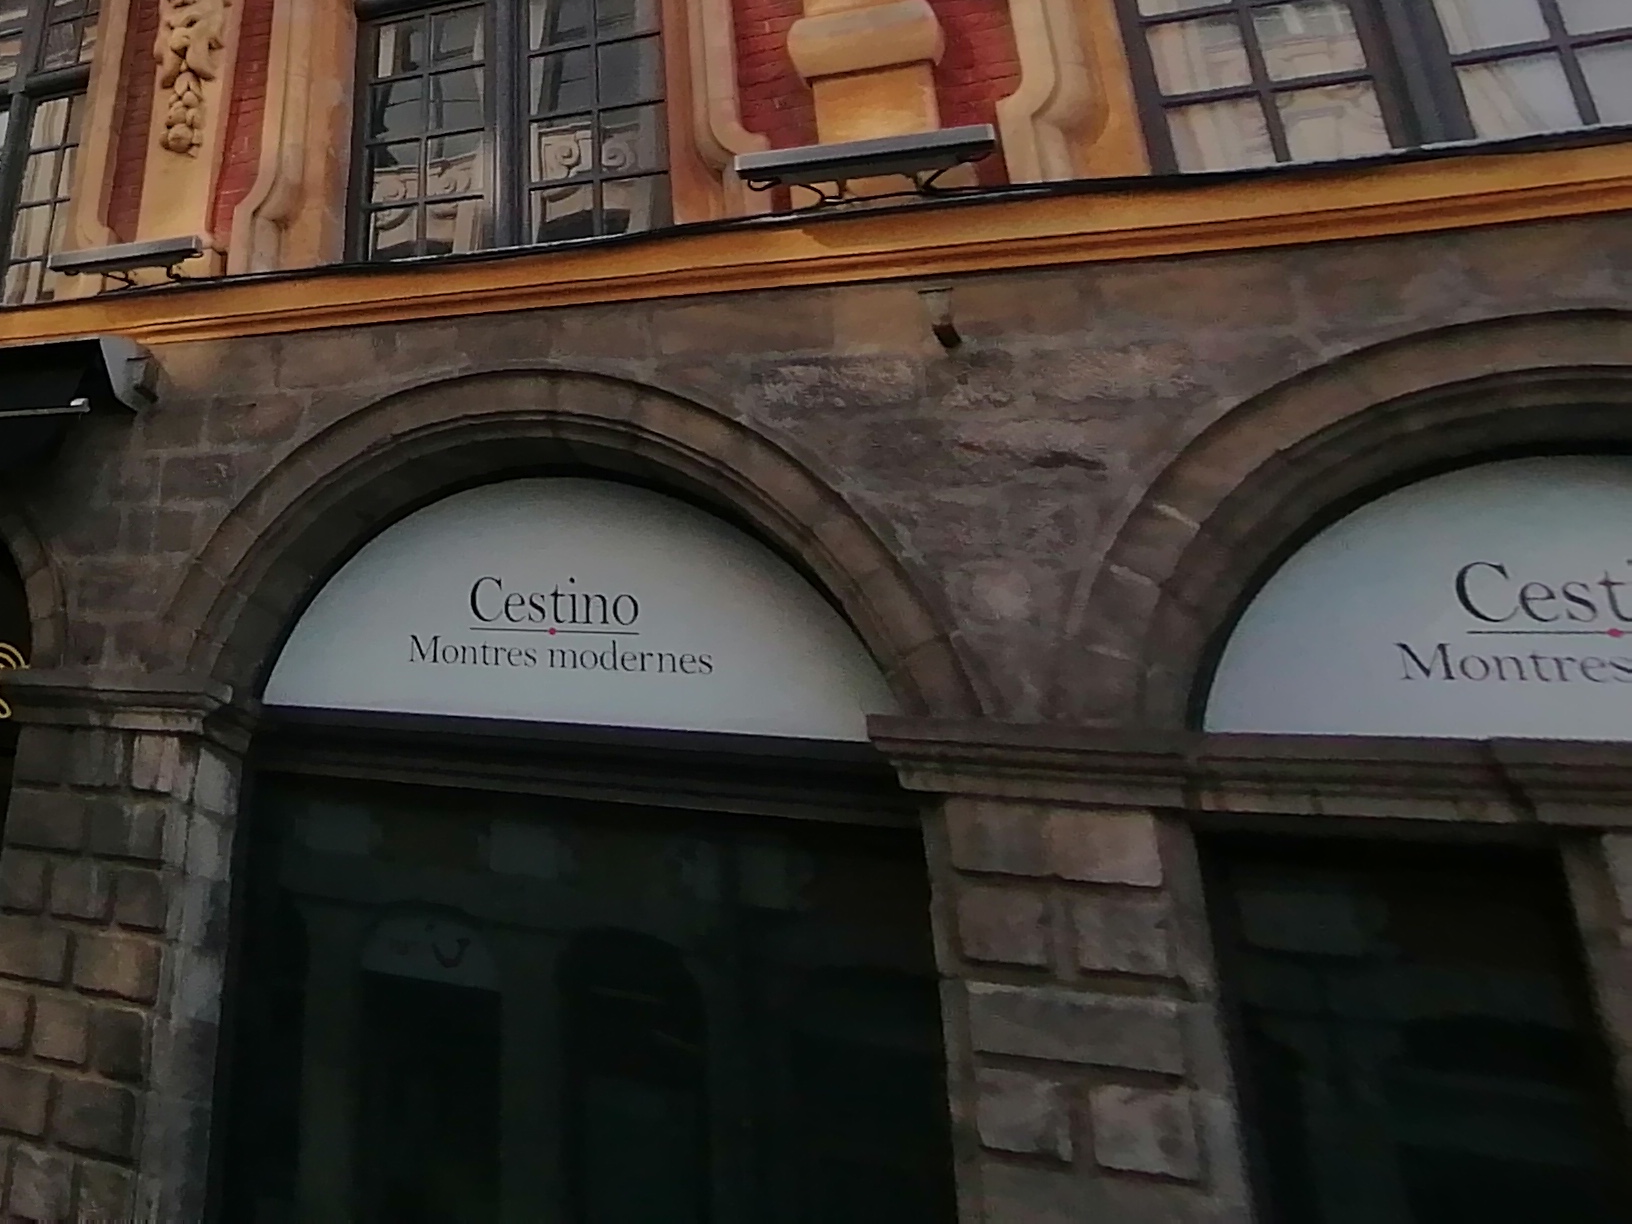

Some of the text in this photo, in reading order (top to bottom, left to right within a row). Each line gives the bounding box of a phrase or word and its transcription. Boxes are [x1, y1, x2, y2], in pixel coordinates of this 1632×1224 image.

[469, 576, 640, 626] Cestino
[1454, 560, 1632, 623] Cest
[408, 634, 715, 675] Montres modernes
